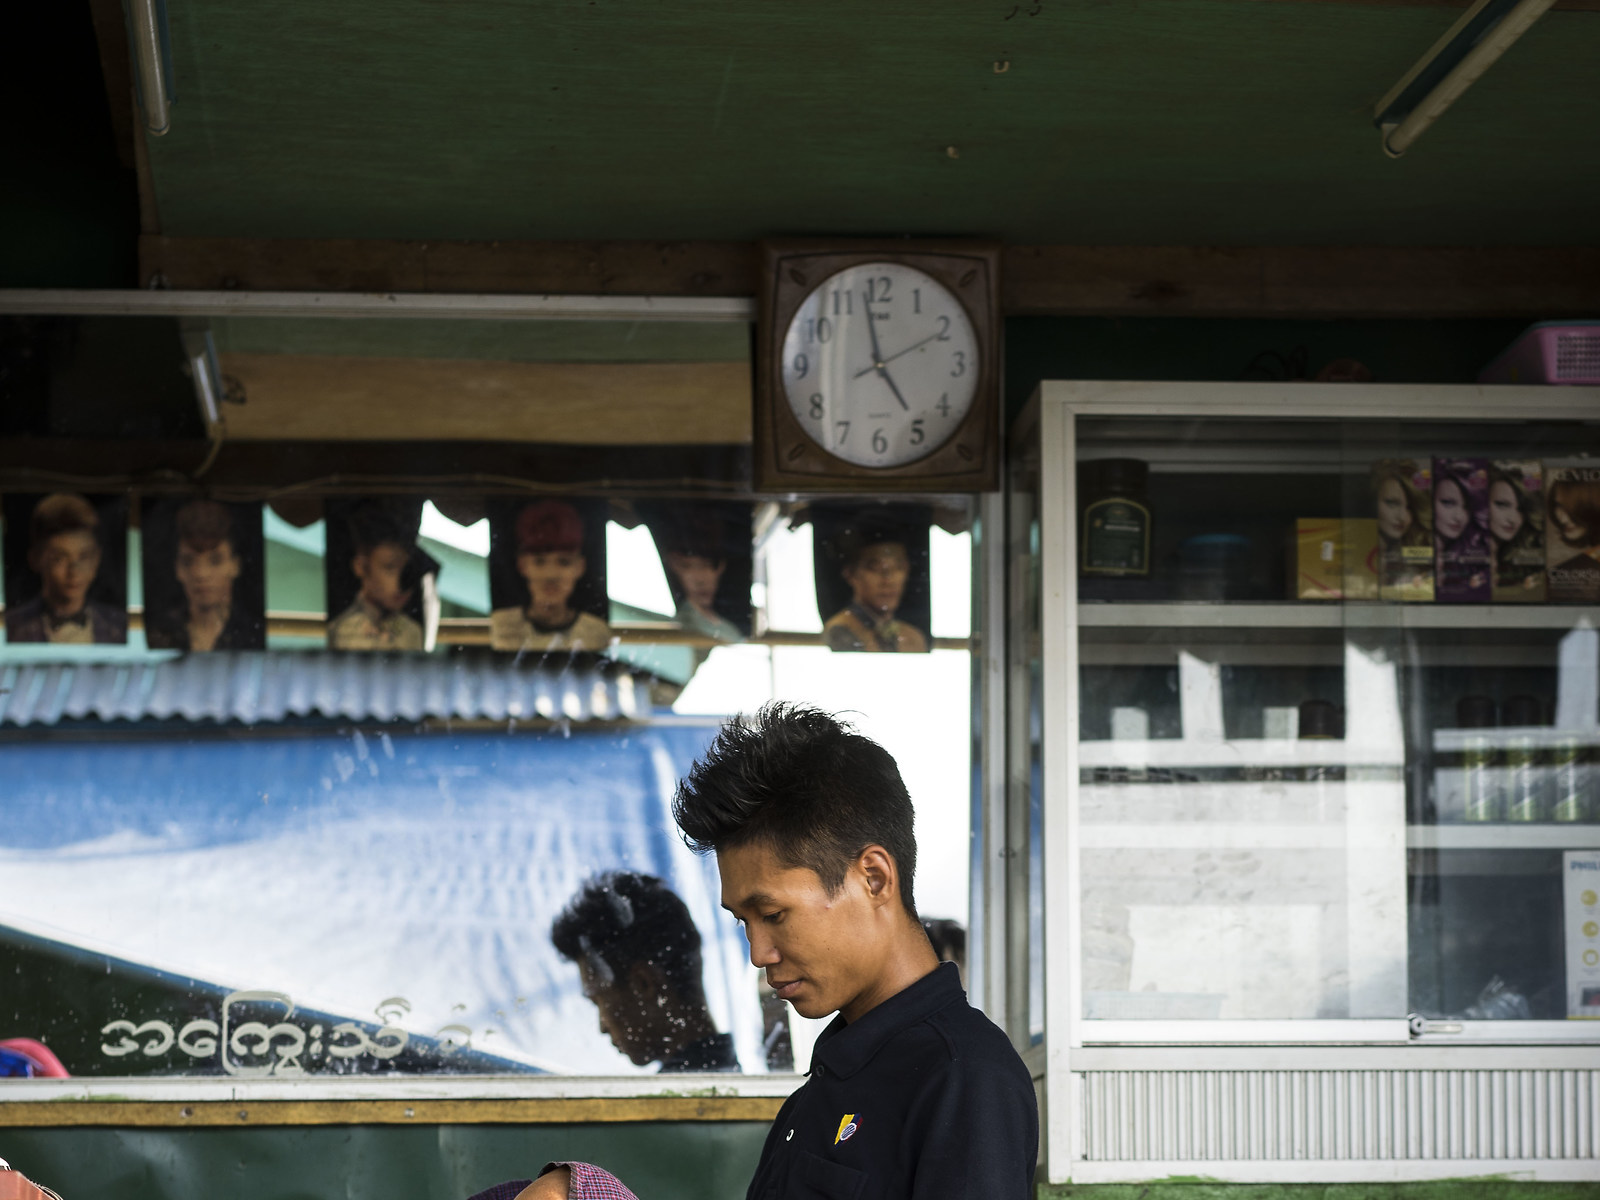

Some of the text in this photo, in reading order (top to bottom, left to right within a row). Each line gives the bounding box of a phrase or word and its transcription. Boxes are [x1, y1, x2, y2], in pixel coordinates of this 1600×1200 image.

[831, 290, 854, 315] 11
[866, 276, 892, 303] 12
[911, 288, 922, 314] 1
[807, 317, 832, 344] 10
[936, 315, 951, 341] 2
[794, 353, 809, 379] 9
[950, 351, 965, 378] 3
[809, 392, 824, 420] 8
[935, 392, 952, 418] 4
[836, 421, 850, 445] 7
[872, 428, 888, 454] 6
[910, 419, 925, 445] 5
